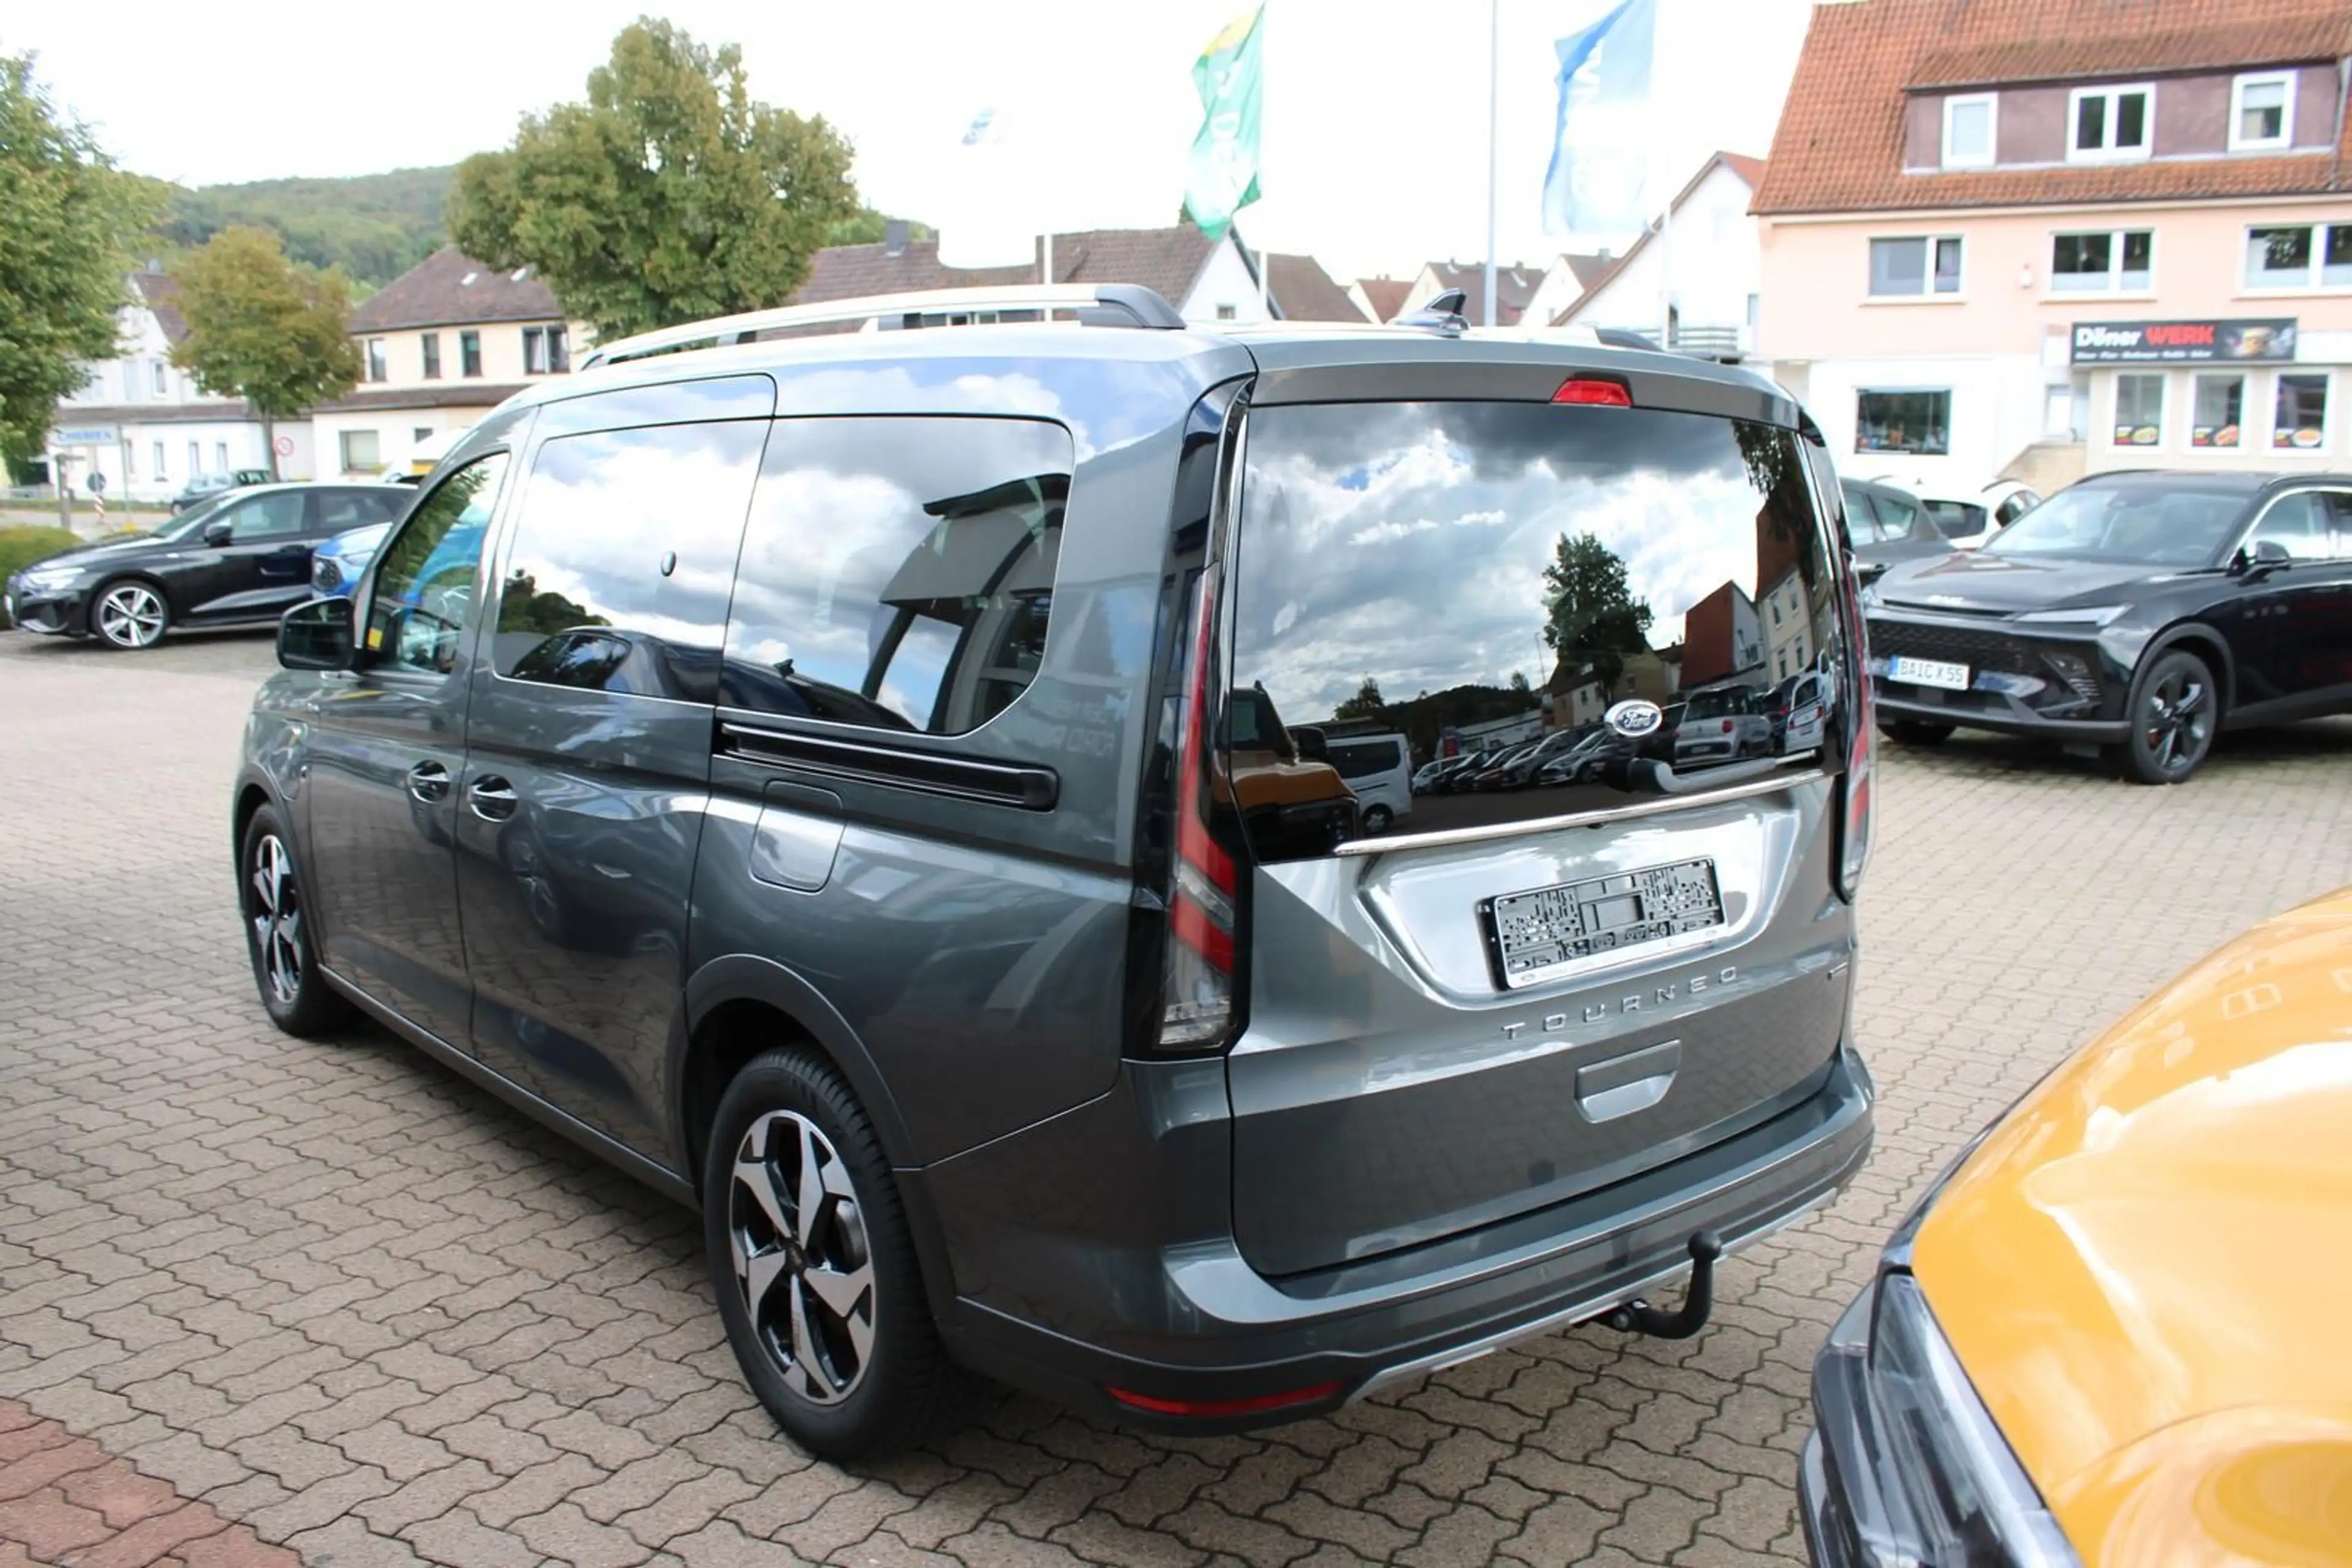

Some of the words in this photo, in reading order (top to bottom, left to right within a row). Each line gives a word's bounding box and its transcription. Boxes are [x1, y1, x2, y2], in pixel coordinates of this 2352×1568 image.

[2076, 326, 2141, 347] Döner
[2147, 325, 2215, 345] WERK
[1501, 966, 1738, 1040] TOURNEO
